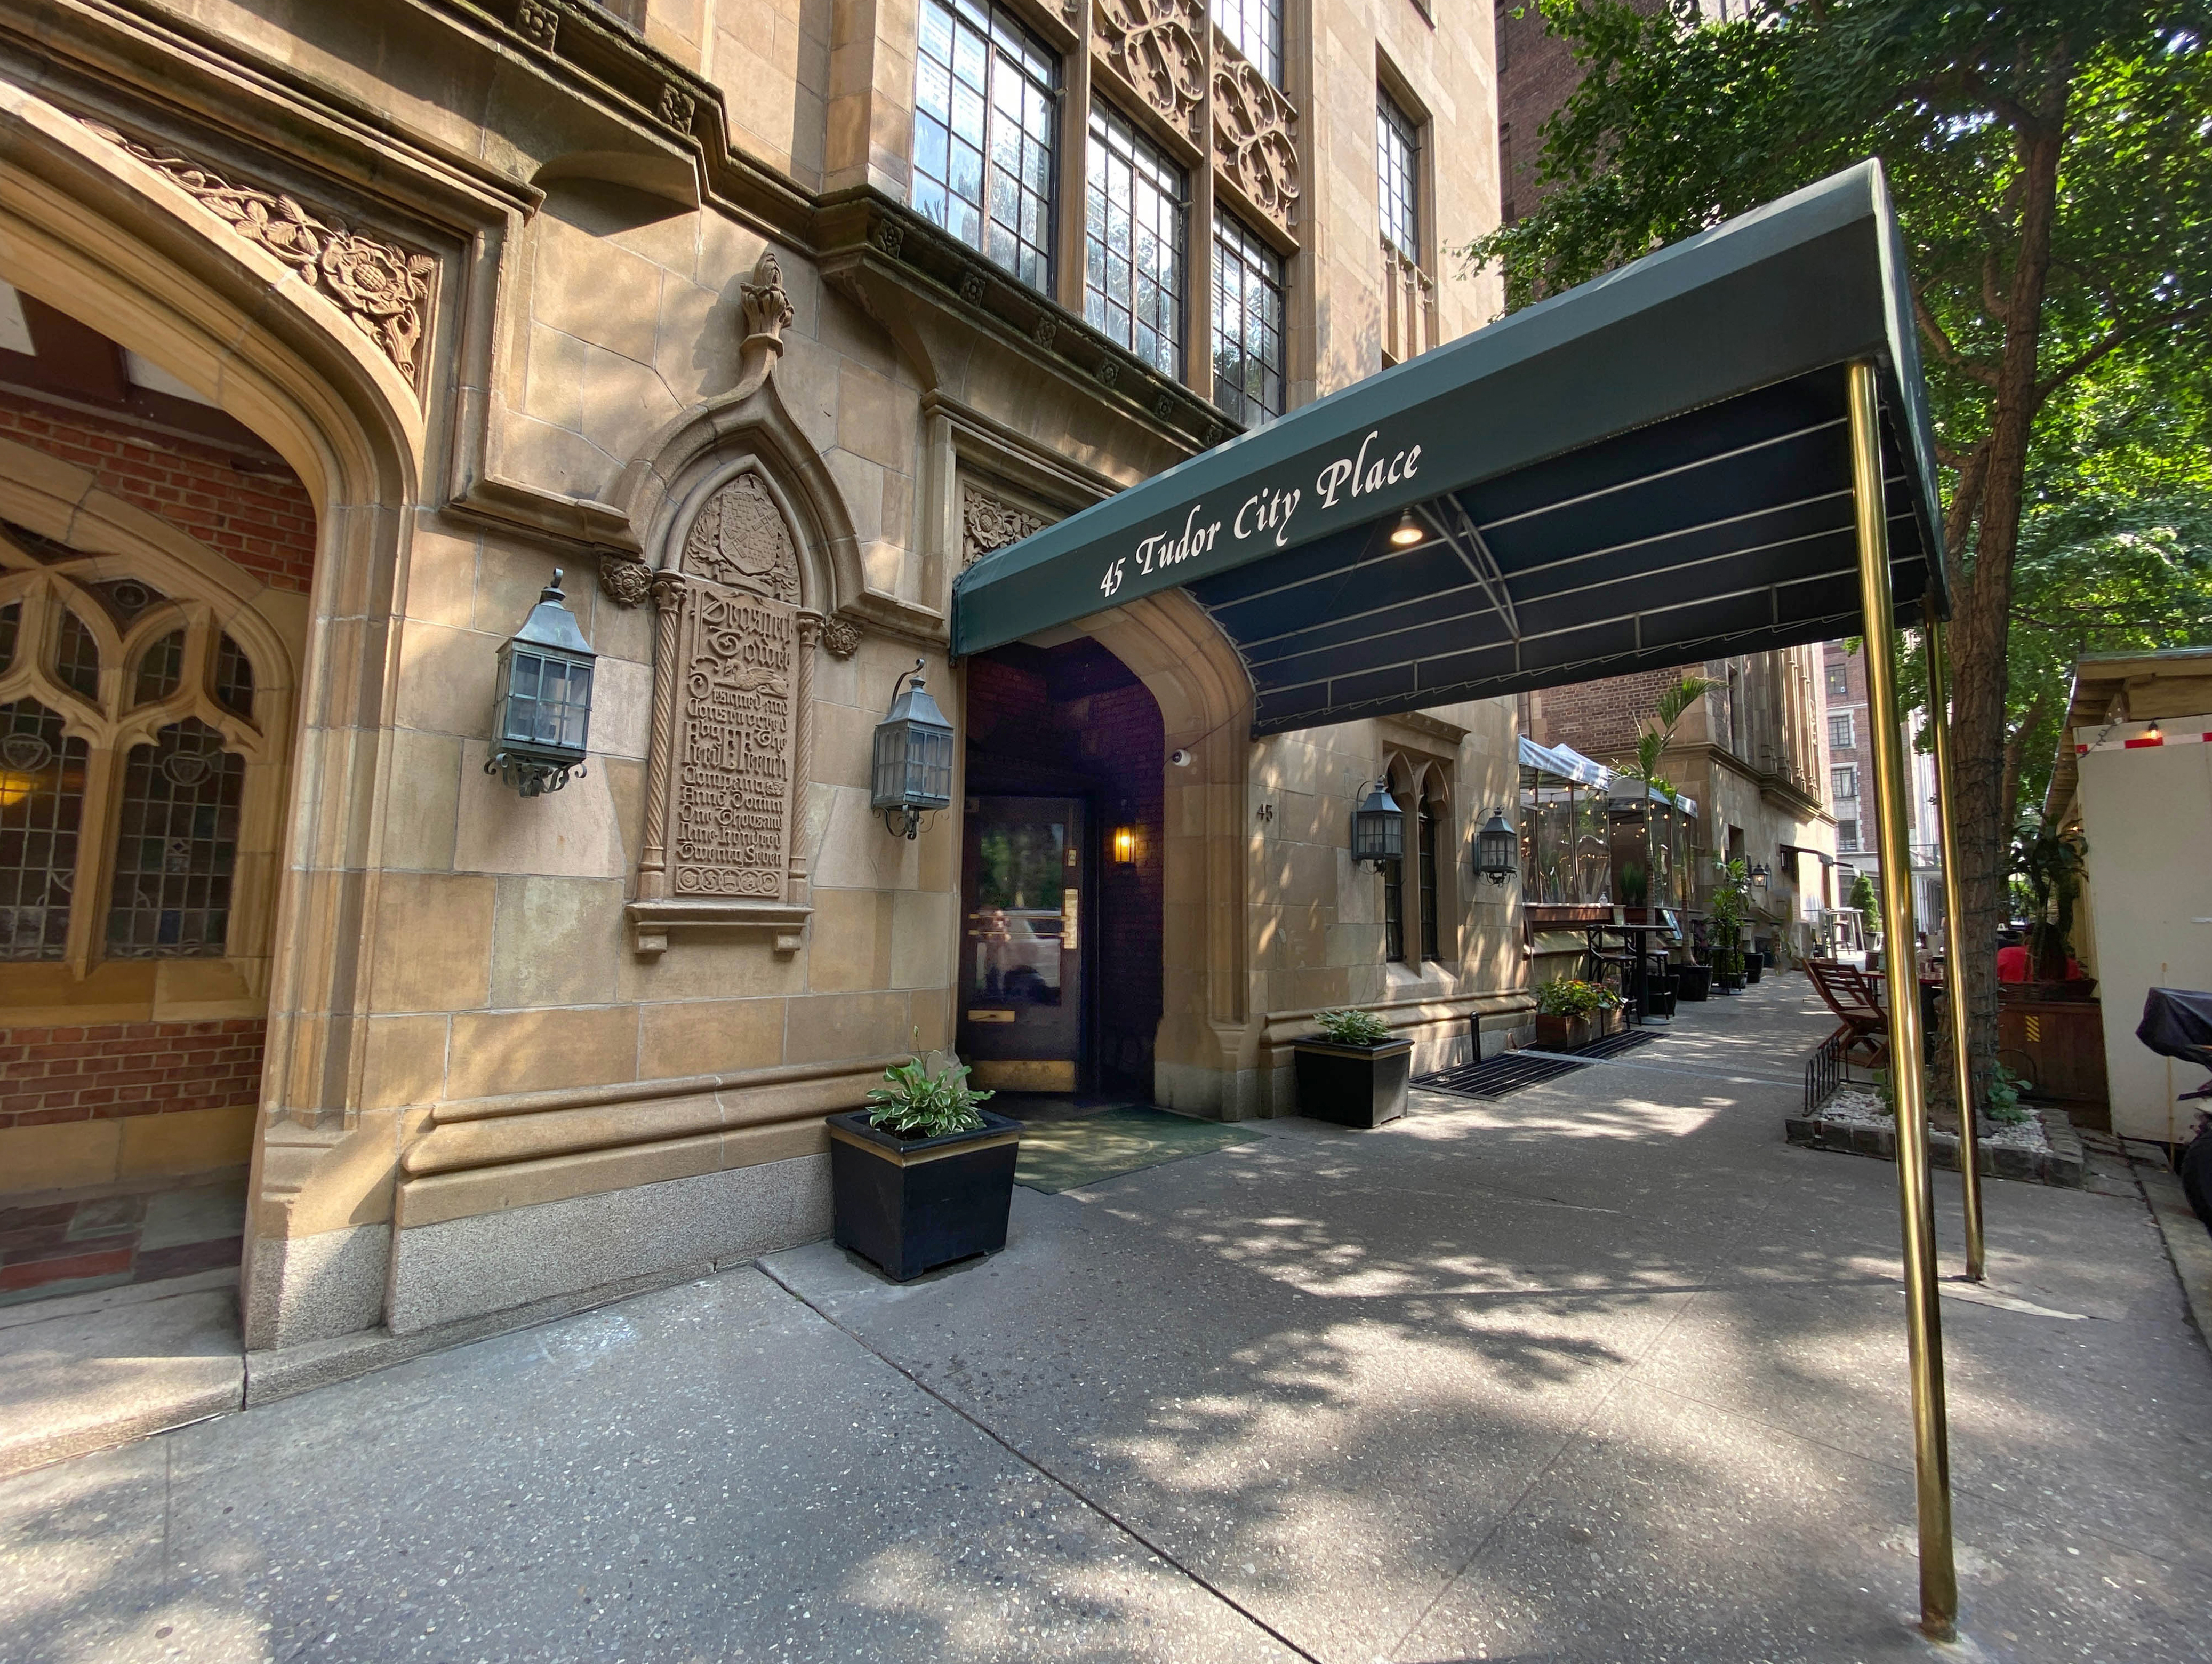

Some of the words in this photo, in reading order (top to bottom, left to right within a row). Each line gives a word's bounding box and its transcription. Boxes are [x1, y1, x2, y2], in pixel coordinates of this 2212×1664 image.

[1100, 557, 1126, 598] 45
[1135, 505, 1221, 575] Tudor
[1233, 487, 1301, 547] City
[1316, 430, 1422, 509] Place
[1256, 804, 1273, 822] 45
